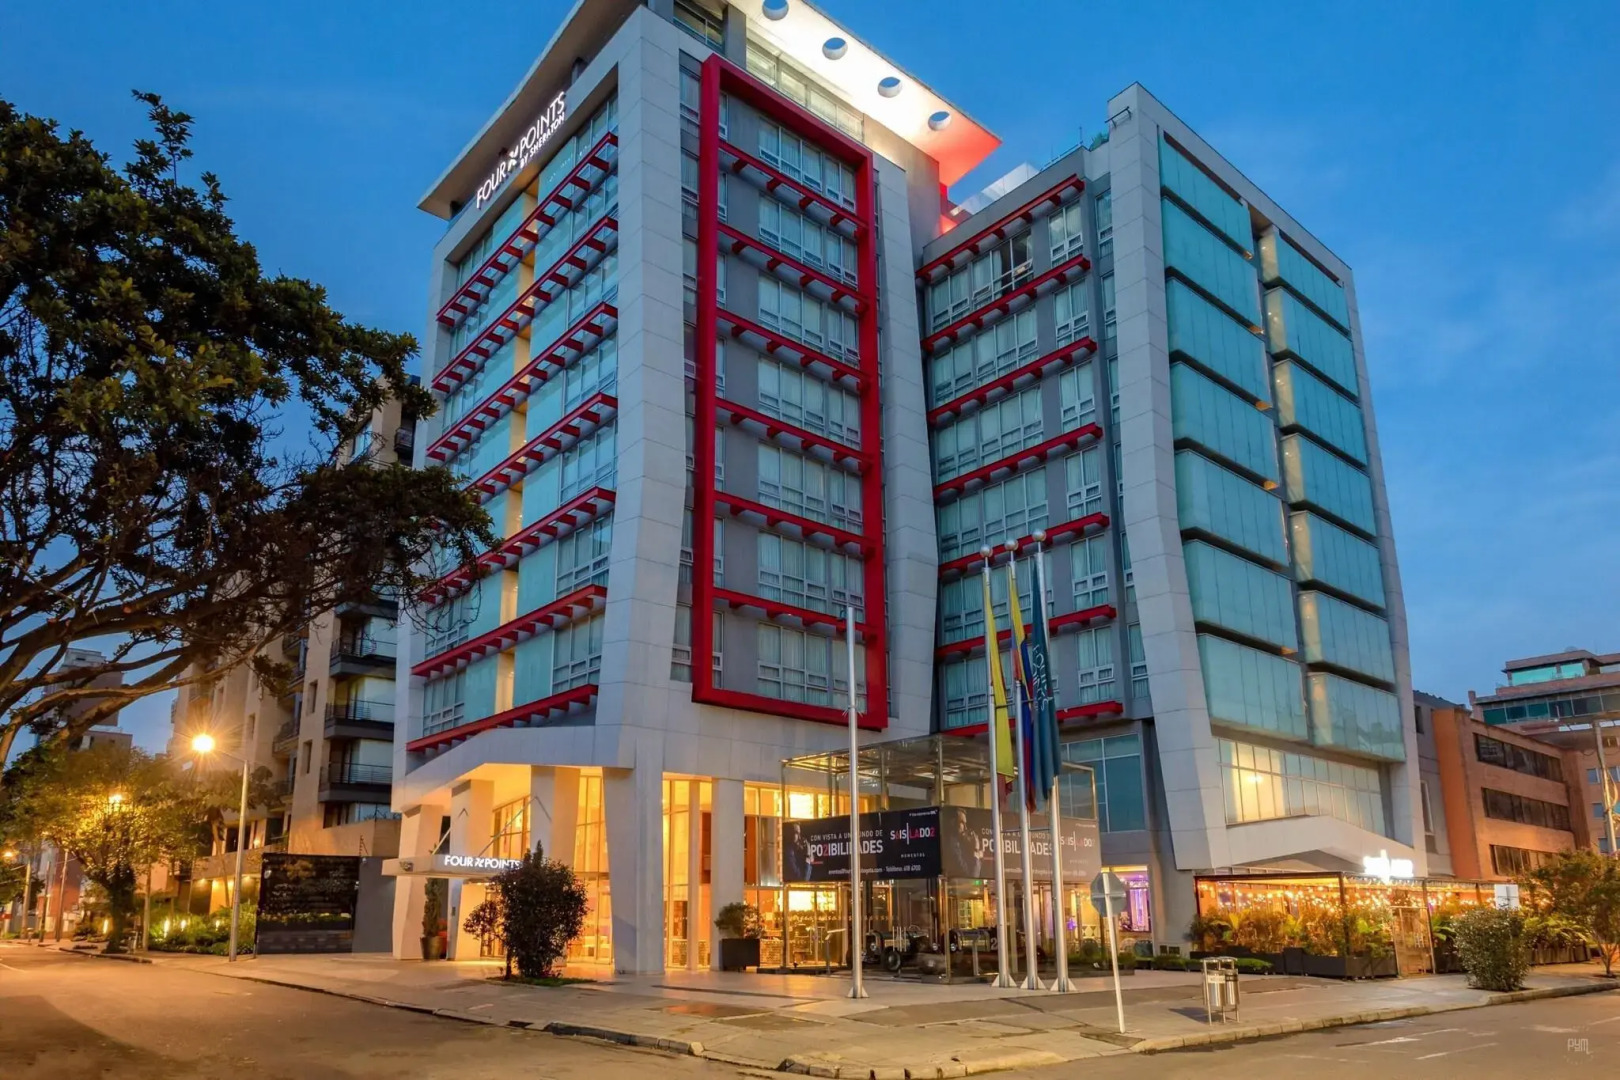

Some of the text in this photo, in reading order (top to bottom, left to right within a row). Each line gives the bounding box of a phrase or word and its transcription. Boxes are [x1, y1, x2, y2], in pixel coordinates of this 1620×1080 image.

[476, 91, 565, 209] FOUR POINTS
[520, 154, 528, 169] BY
[822, 833, 837, 841] VISTA
[875, 829, 883, 837] DE
[444, 855, 520, 870] FOUR POINTS
